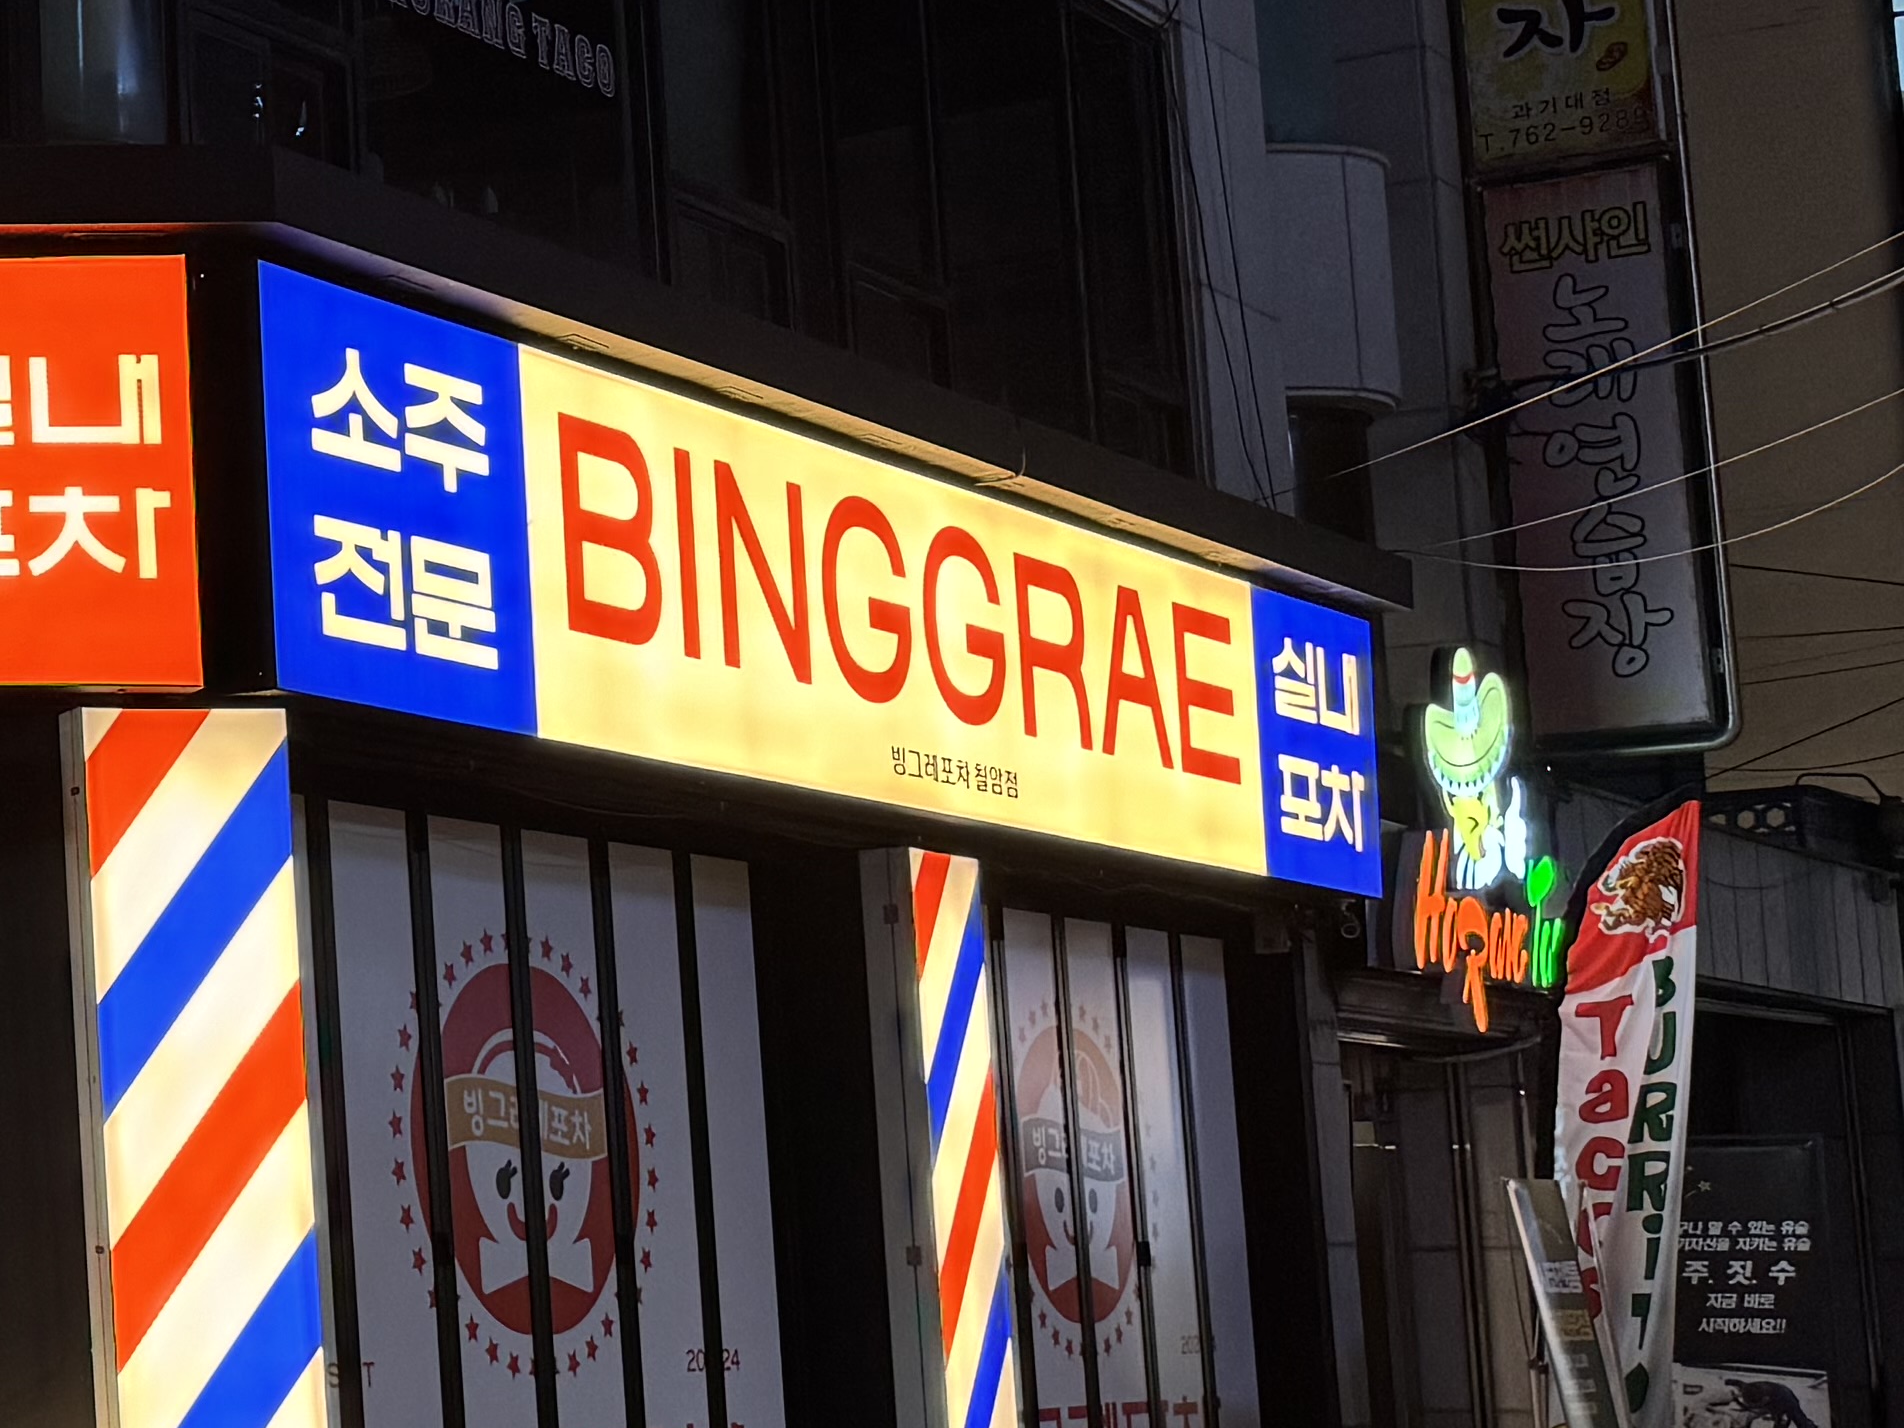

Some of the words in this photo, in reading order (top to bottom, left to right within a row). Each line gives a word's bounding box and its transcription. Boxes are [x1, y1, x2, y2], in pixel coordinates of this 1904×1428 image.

[531, 10, 615, 98] TACO
[1500, 200, 1651, 274] 썬샤인
[309, 346, 491, 495] 소주
[311, 513, 500, 672] 전문
[555, 410, 1244, 786] BINGGRAE
[1270, 632, 1362, 737] 실내
[890, 742, 972, 792] 빙그레포차
[1278, 758, 1368, 855] 포차
[1743, 1293, 1776, 1309] 바로
[1768, 1260, 1796, 1286] 수
